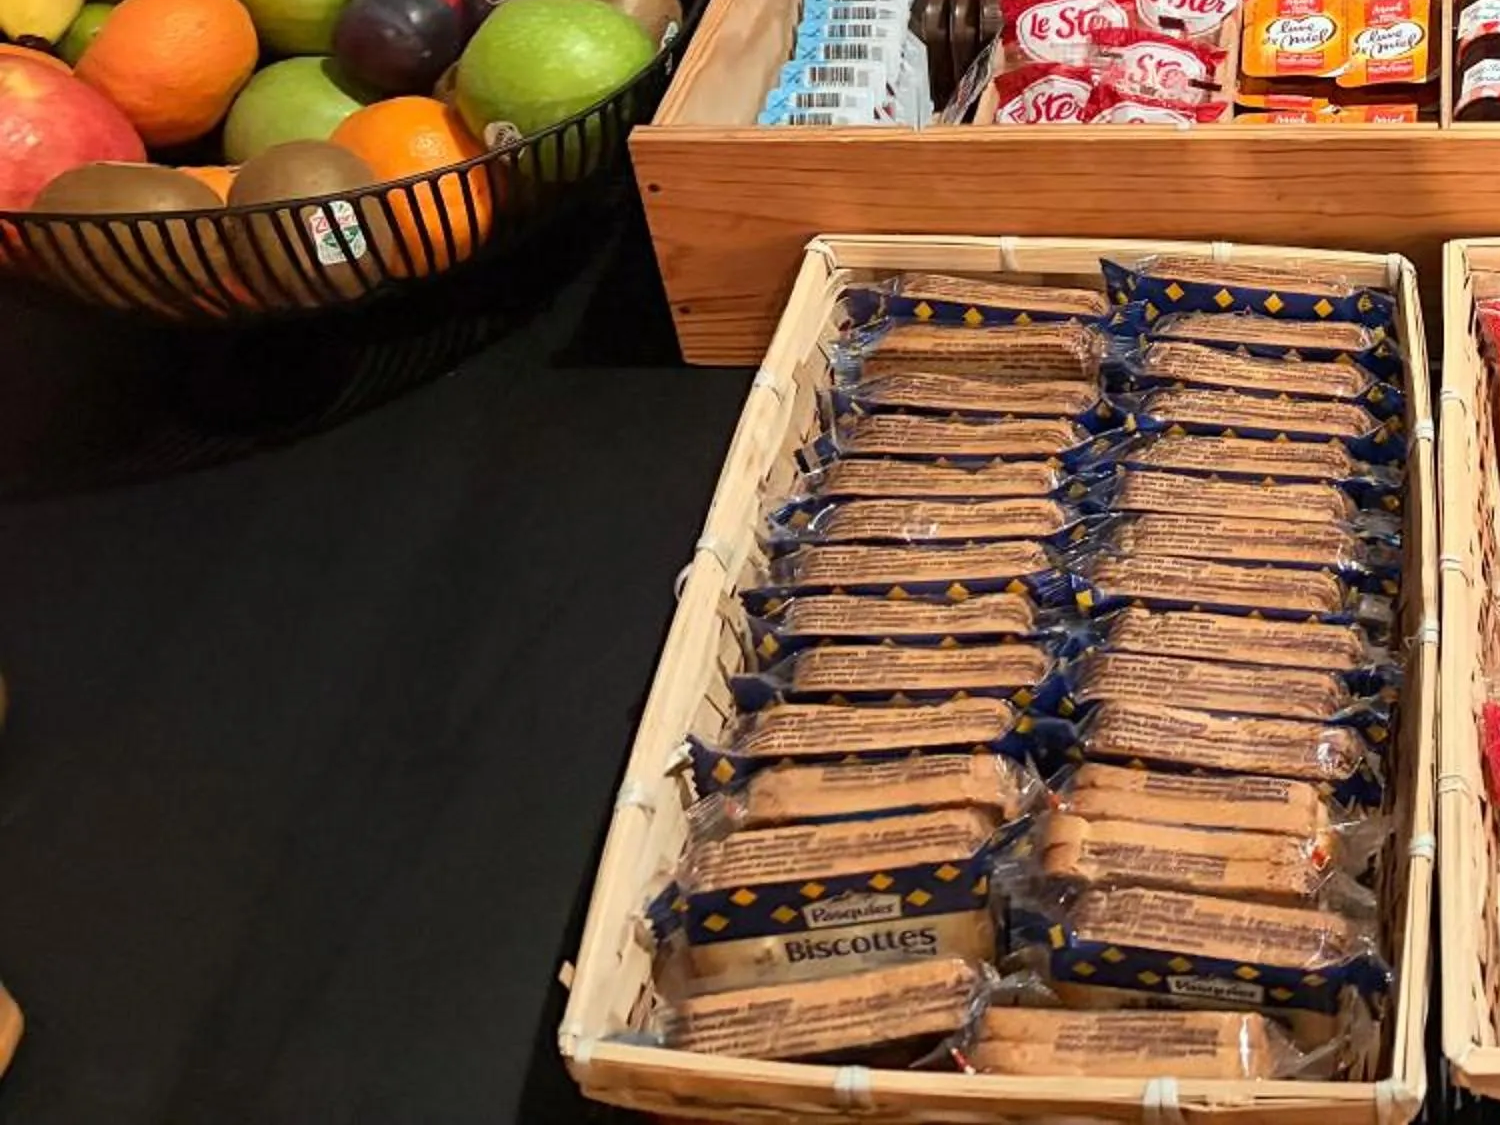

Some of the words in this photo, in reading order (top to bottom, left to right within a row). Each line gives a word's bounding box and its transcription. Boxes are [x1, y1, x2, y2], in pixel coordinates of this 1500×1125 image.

[1029, 12, 1050, 40] Le
[810, 900, 896, 925] Pasquier
[783, 925, 938, 964] Biscottes
